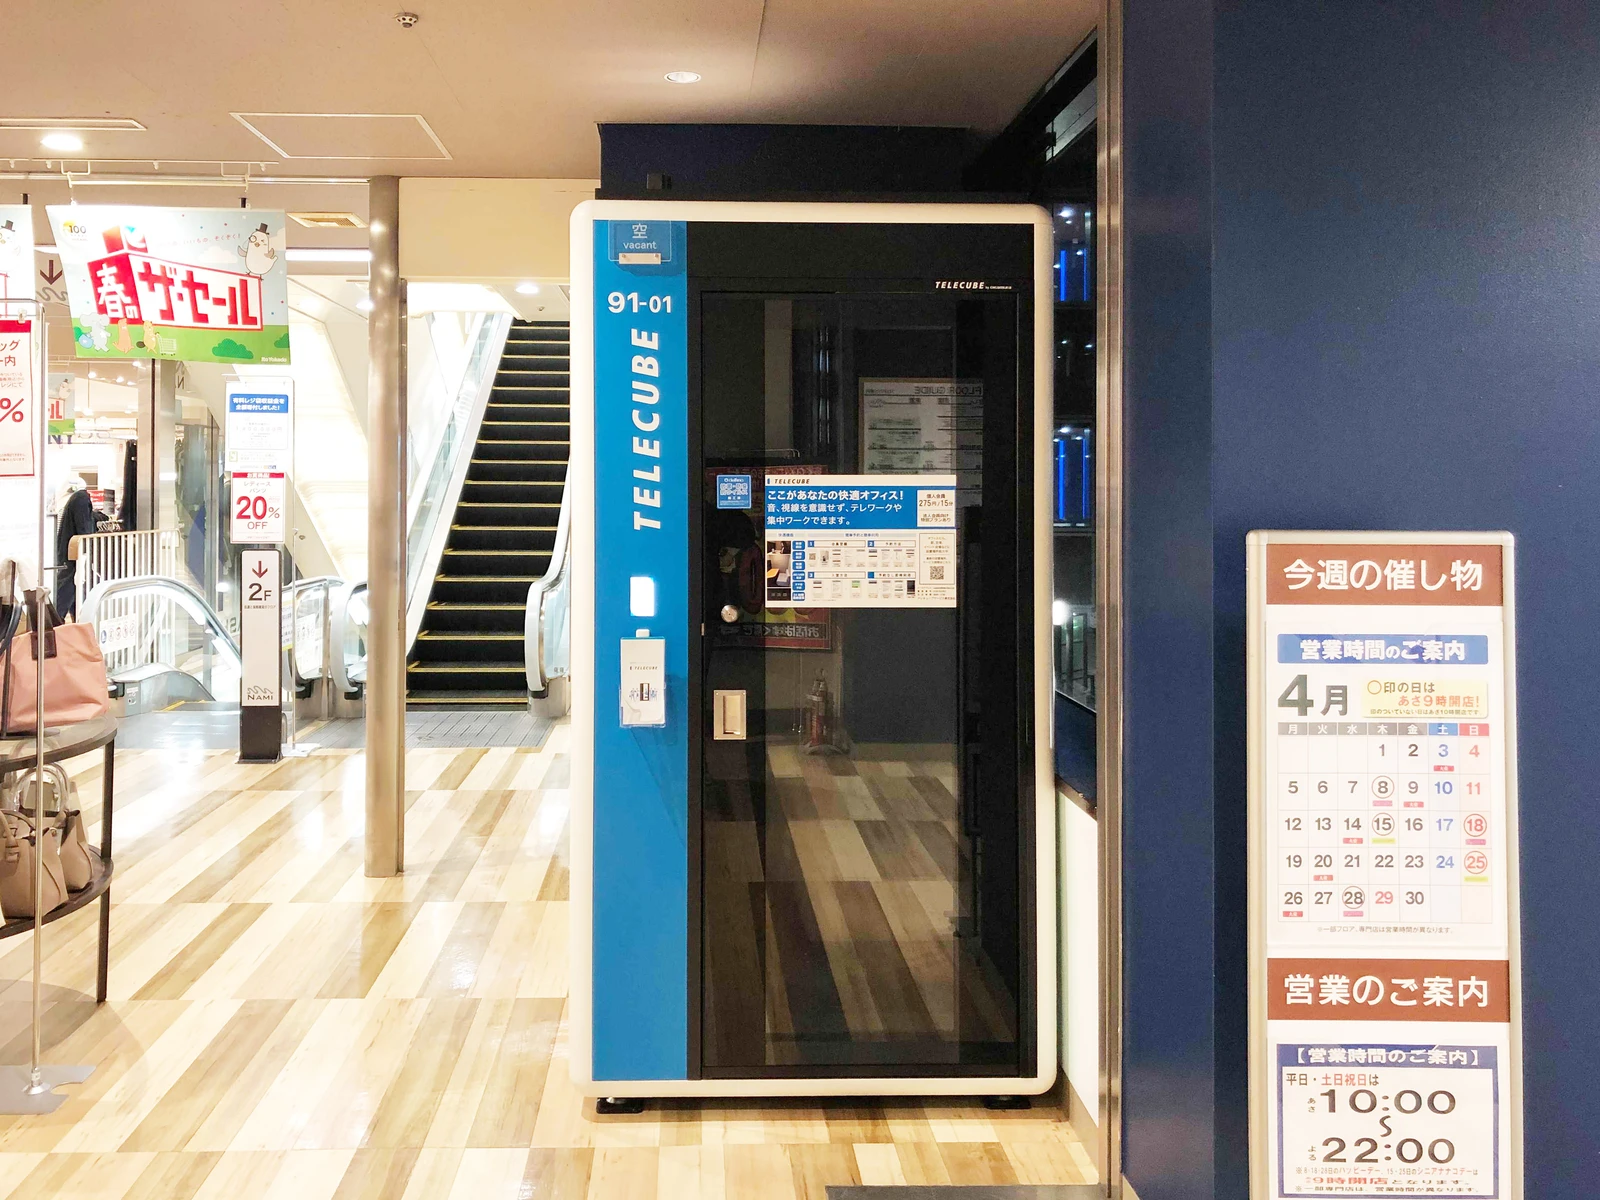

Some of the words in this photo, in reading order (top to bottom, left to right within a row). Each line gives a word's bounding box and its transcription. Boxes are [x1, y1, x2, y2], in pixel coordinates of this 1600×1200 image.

[632, 222, 648, 239] 空
[623, 241, 657, 250] vacant
[96, 263, 138, 319] 春の
[935, 281, 985, 289] TELECUBE
[607, 291, 672, 314] 91-01
[631, 328, 662, 531] TELECUBE
[767, 490, 904, 501] ここがあなたの快適オフィス!
[236, 496, 280, 520] 20%
[766, 503, 902, 514] 音、視線を意識せず、テレワークや
[247, 521, 268, 530] OFF
[766, 515, 851, 526] 集中ワークできます。
[1283, 558, 1484, 591] 今週の催し物
[248, 583, 272, 601] 2F
[1300, 639, 1466, 661] 営業時間のご案内
[1277, 674, 1348, 716] 4月
[1288, 725, 1298, 734] 月
[1318, 725, 1327, 734] 火
[1347, 725, 1358, 734] 水
[1377, 725, 1388, 734] 木
[1407, 725, 1418, 734] 金
[1438, 725, 1449, 734] 土
[1470, 725, 1479, 735] 日
[1379, 744, 1385, 756] 1
[1408, 744, 1418, 757] 2
[1438, 744, 1449, 757] 3
[1469, 745, 1480, 757] 4
[1288, 781, 1298, 793] 5
[1317, 781, 1328, 793] 6
[1348, 781, 1358, 793] 7
[1378, 781, 1388, 794] 8
[1408, 781, 1418, 794] 9
[1435, 782, 1453, 794] 10
[1466, 782, 1481, 795] 11
[1285, 818, 1301, 831] 12
[1315, 818, 1332, 831] 13
[1344, 818, 1361, 831] 14
[1374, 818, 1392, 831] 15
[1405, 818, 1423, 831] 16
[1436, 819, 1453, 831] 17
[1467, 819, 1483, 832] 18
[1286, 855, 1302, 868] 19
[1314, 855, 1332, 868] 20
[1344, 855, 1360, 868] 21
[1374, 855, 1394, 868] 22
[1405, 855, 1424, 868] 23
[1436, 856, 1454, 868] 24
[1467, 856, 1485, 869] 25
[1284, 892, 1303, 905] 26
[1314, 892, 1332, 905] 27
[1344, 892, 1363, 905] 28
[1375, 891, 1393, 904] 29
[1405, 892, 1424, 905] 30
[1284, 974, 1489, 1008] 営業のご案内
[1297, 1047, 1480, 1066] 【営業時間のご案内】
[1286, 1073, 1379, 1086] 平日・土日祝日は
[1307, 1097, 1316, 1113] あさ
[1320, 1089, 1456, 1115] 10:00
[1308, 1146, 1317, 1161] よる
[1322, 1137, 1456, 1163] 22:00
